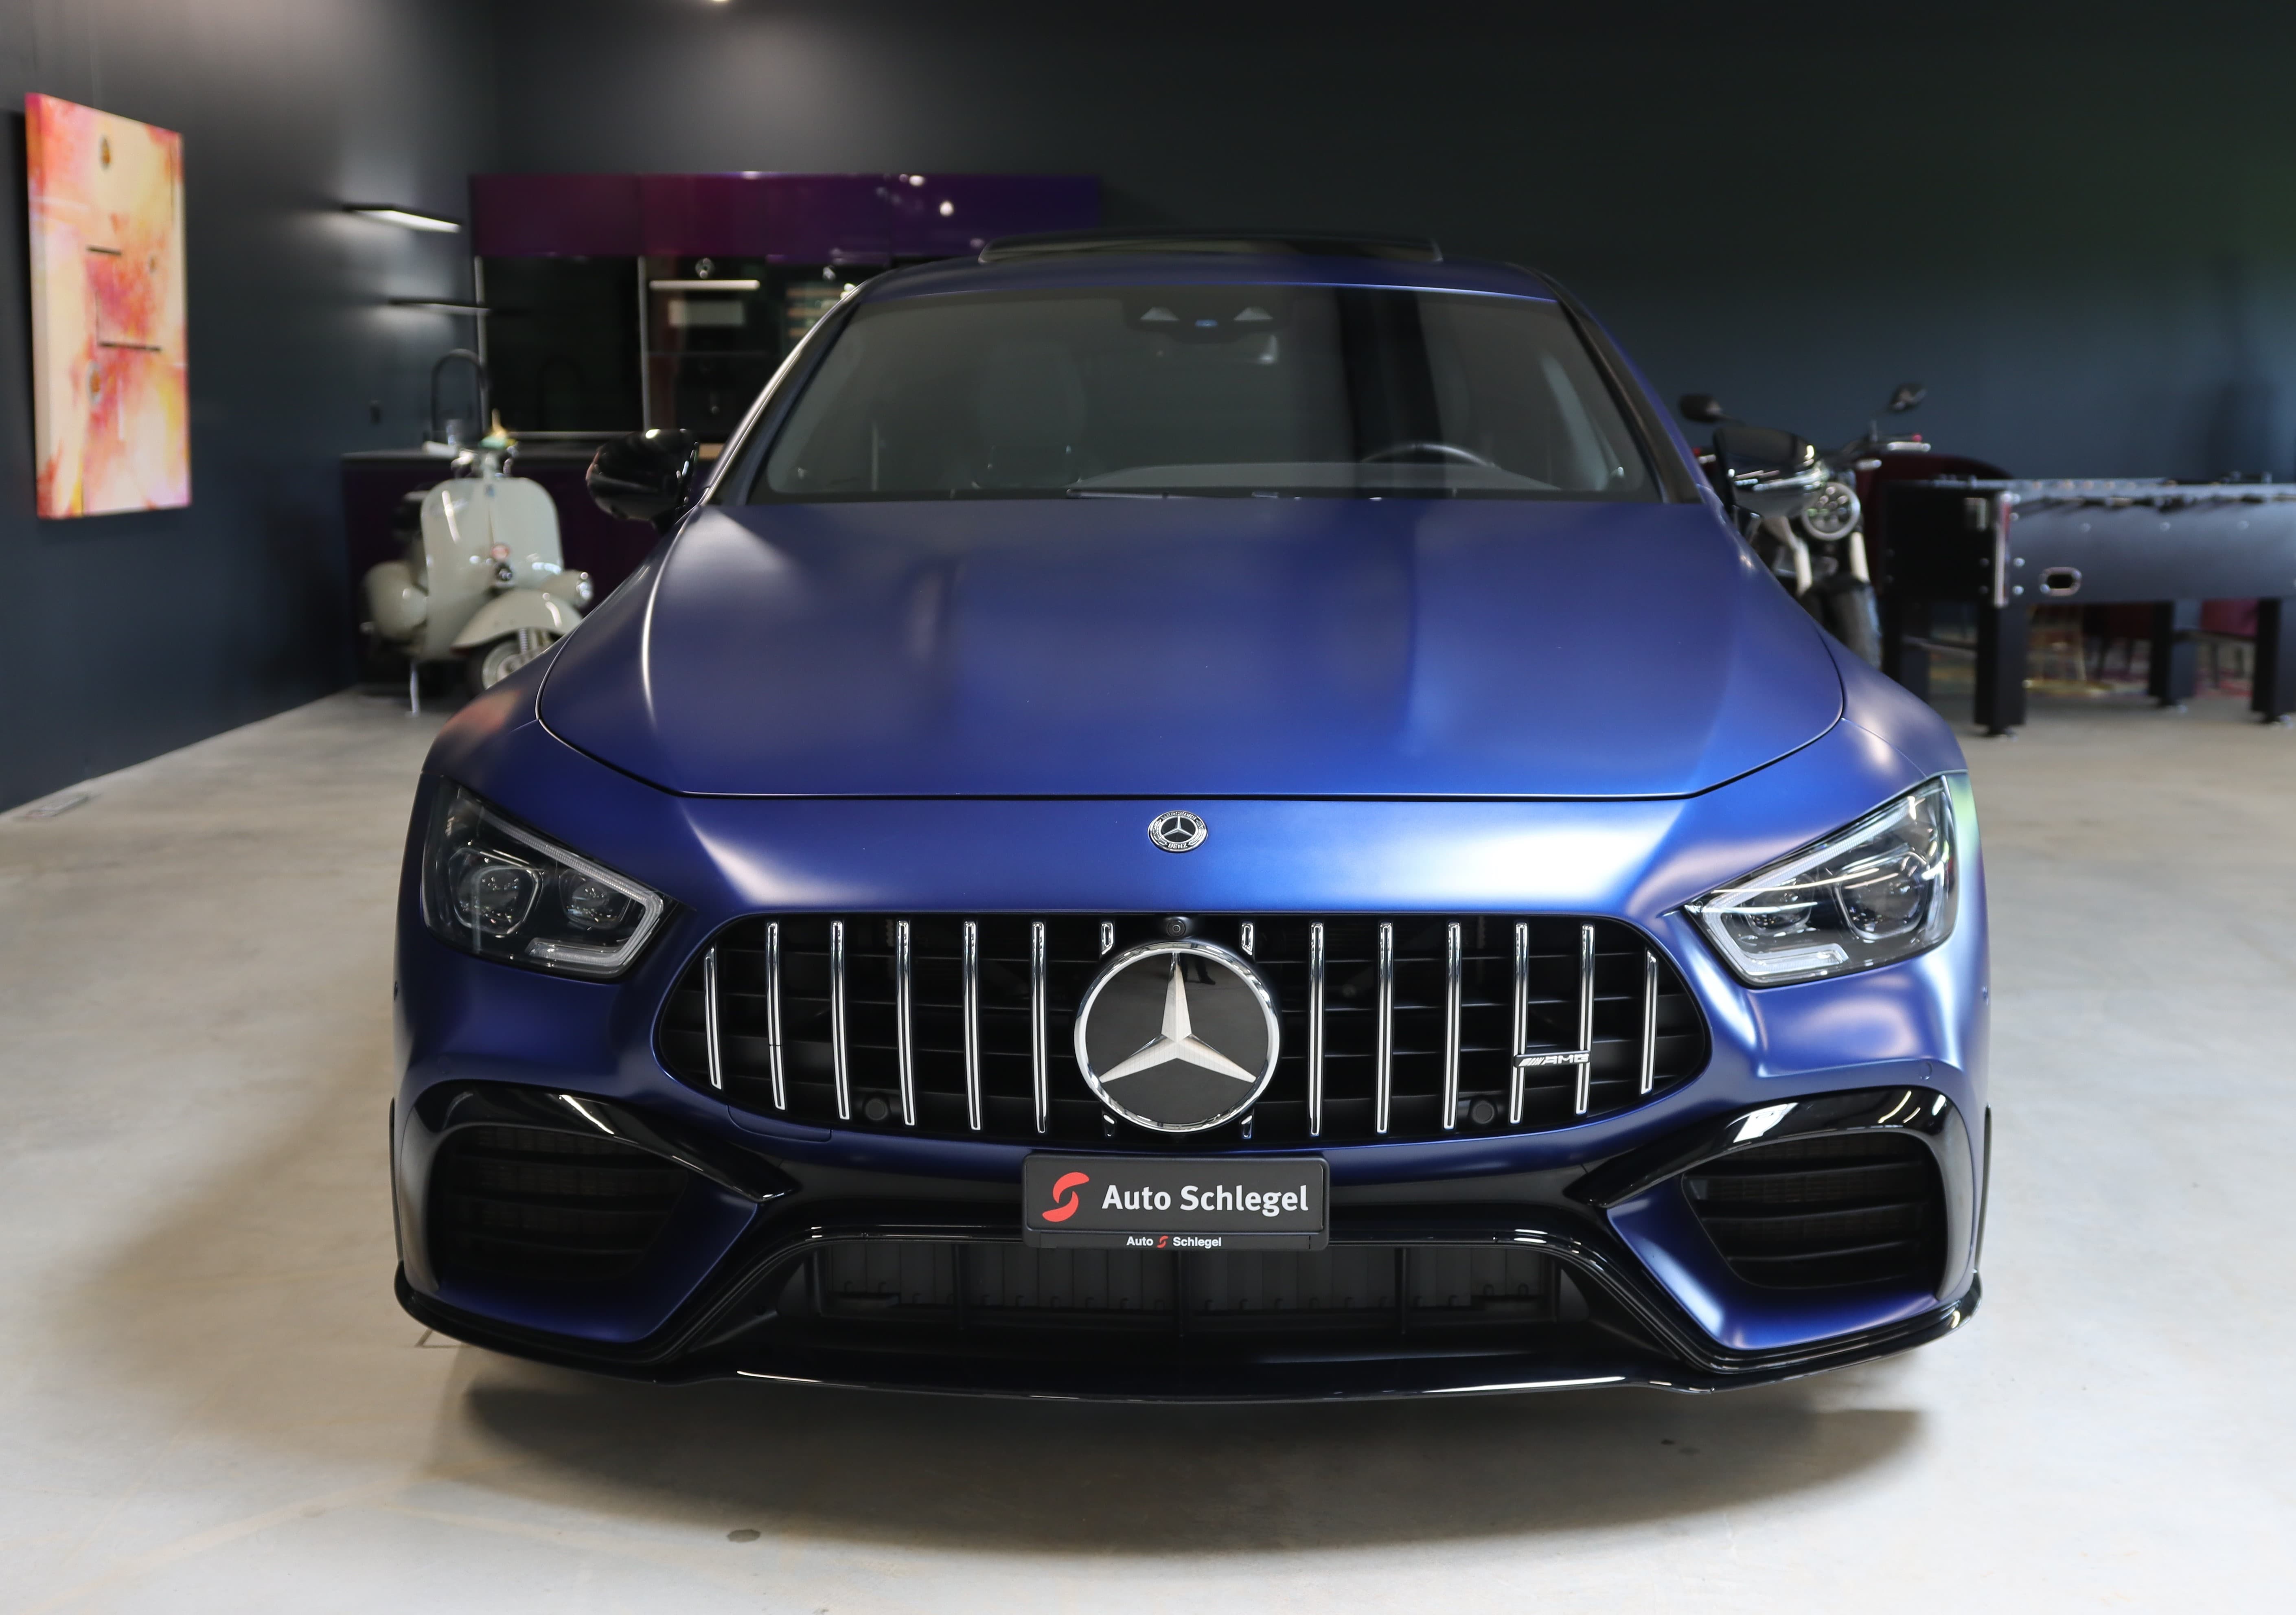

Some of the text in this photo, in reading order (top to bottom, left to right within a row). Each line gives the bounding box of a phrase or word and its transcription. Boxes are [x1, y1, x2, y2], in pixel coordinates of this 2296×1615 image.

[1542, 1053, 1589, 1065] AMG
[1102, 1185, 1309, 1217] Auto Schlegel
[1126, 1236, 1222, 1249] Auto Schlegel
